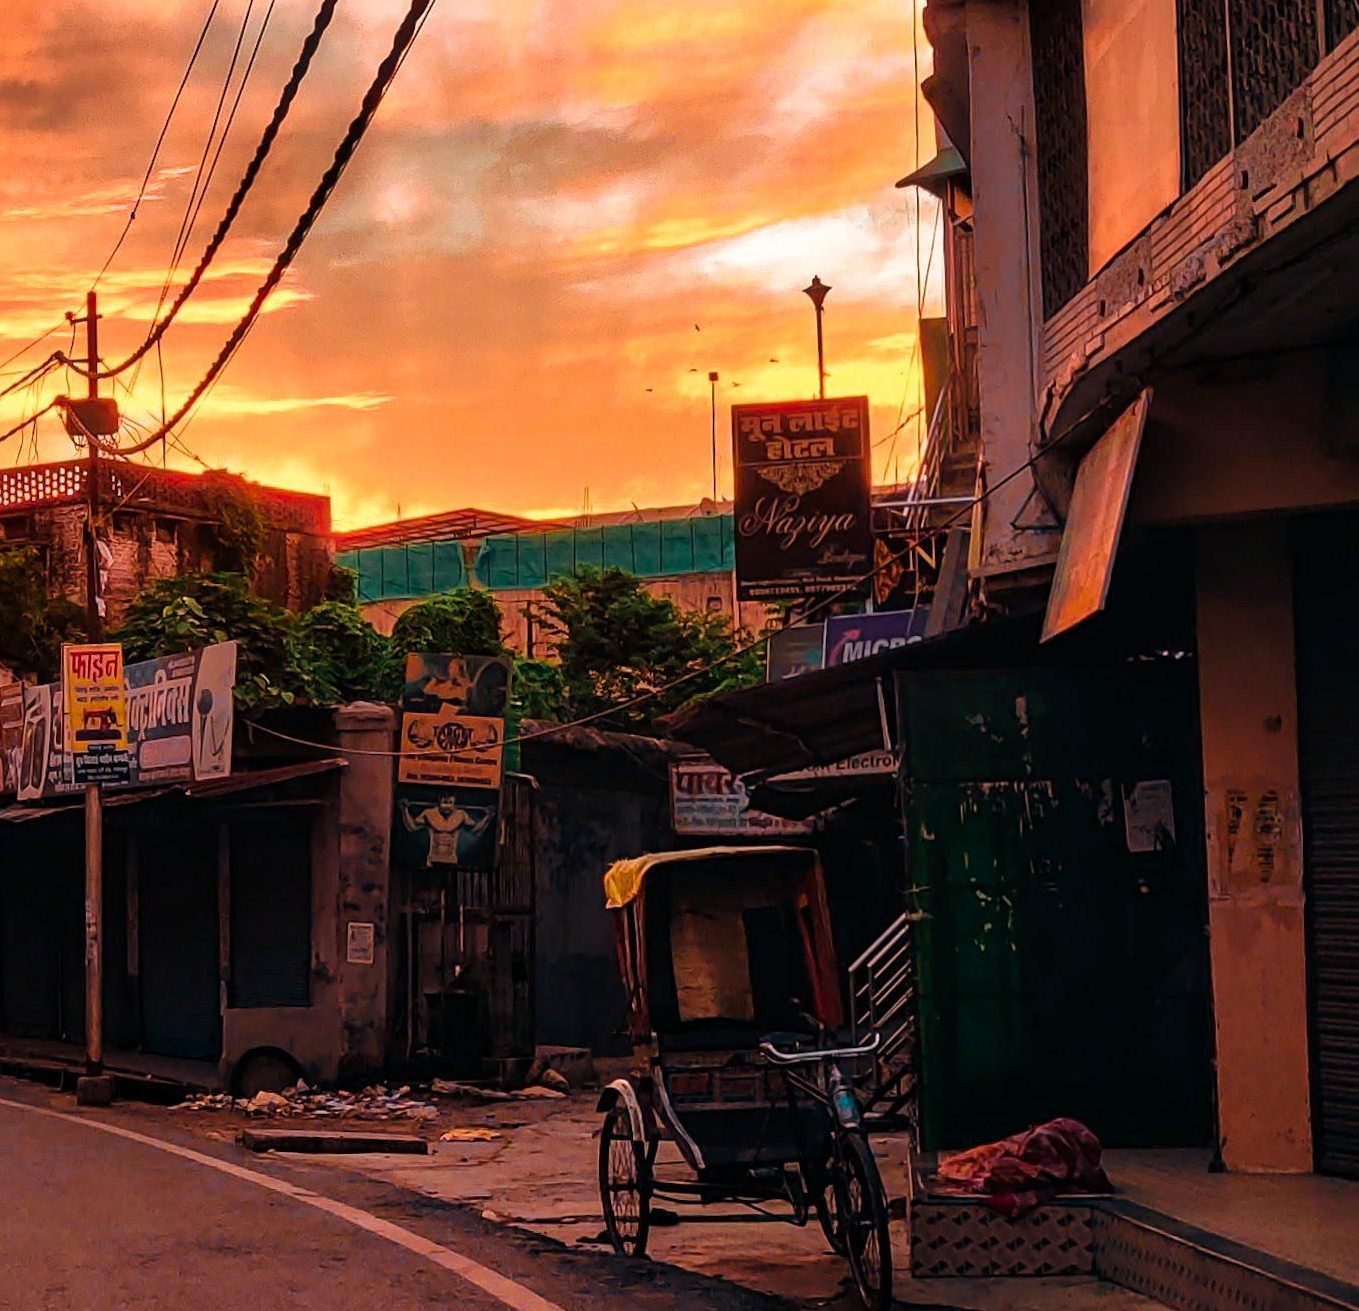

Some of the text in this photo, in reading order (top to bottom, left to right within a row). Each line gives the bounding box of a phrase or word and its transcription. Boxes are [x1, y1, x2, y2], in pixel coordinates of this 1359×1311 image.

[765, 436, 836, 460] होटल
[739, 495, 856, 551] Naziya
[70, 651, 120, 682] फाइन
